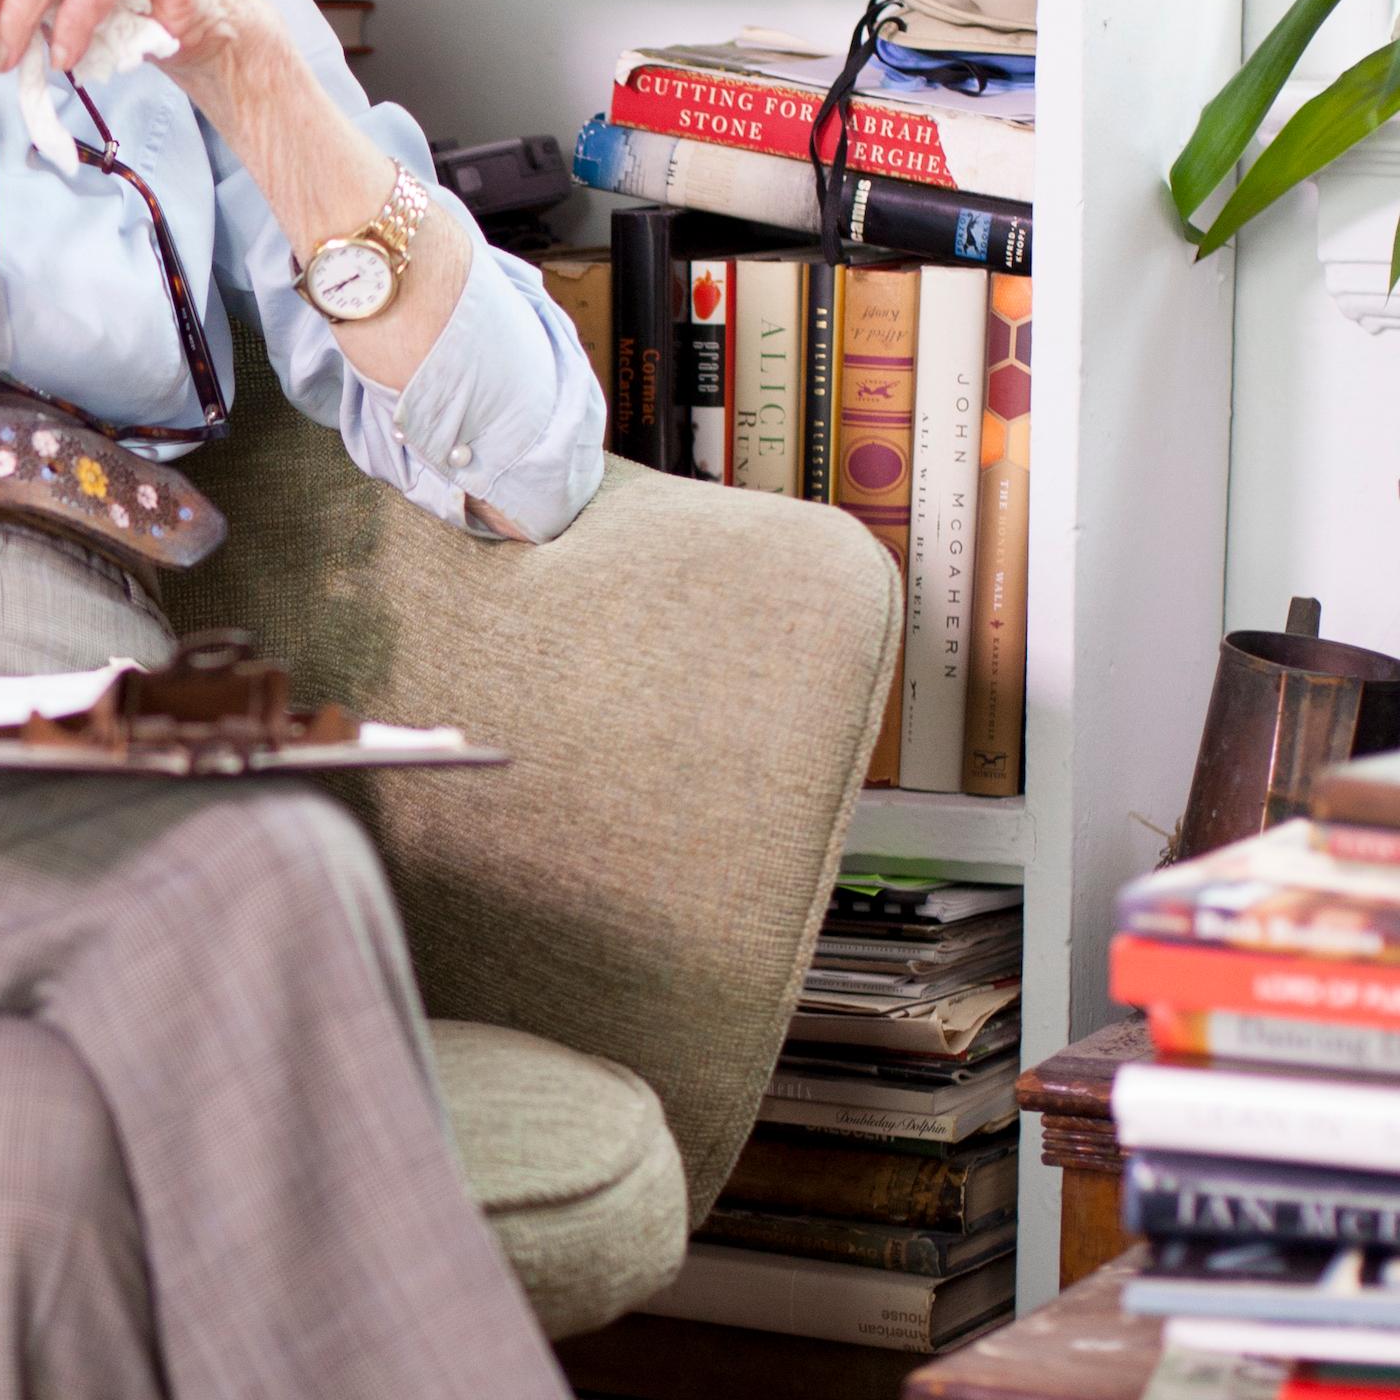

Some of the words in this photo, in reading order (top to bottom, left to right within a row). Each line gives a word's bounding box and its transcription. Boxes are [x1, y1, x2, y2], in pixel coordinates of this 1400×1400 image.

[636, 73, 754, 114] CUTTING
[764, 96, 815, 123] FOR
[679, 108, 764, 142] STONE
[846, 113, 941, 146] ABRAH
[846, 140, 951, 176] ERGHE
[850, 179, 872, 242] camus
[1013, 228, 1027, 263] KNOPF
[642, 348, 661, 425] Cormac
[693, 341, 720, 393] grace
[759, 319, 787, 456] ALICE
[920, 411, 930, 455] ALL
[953, 372, 971, 464] JOHN
[917, 467, 928, 523] WILL
[999, 478, 1010, 510] THE
[912, 575, 923, 636] WELL
[993, 570, 1006, 612] WALL
[835, 1110, 947, 1137] Doubleday/Dolphin
